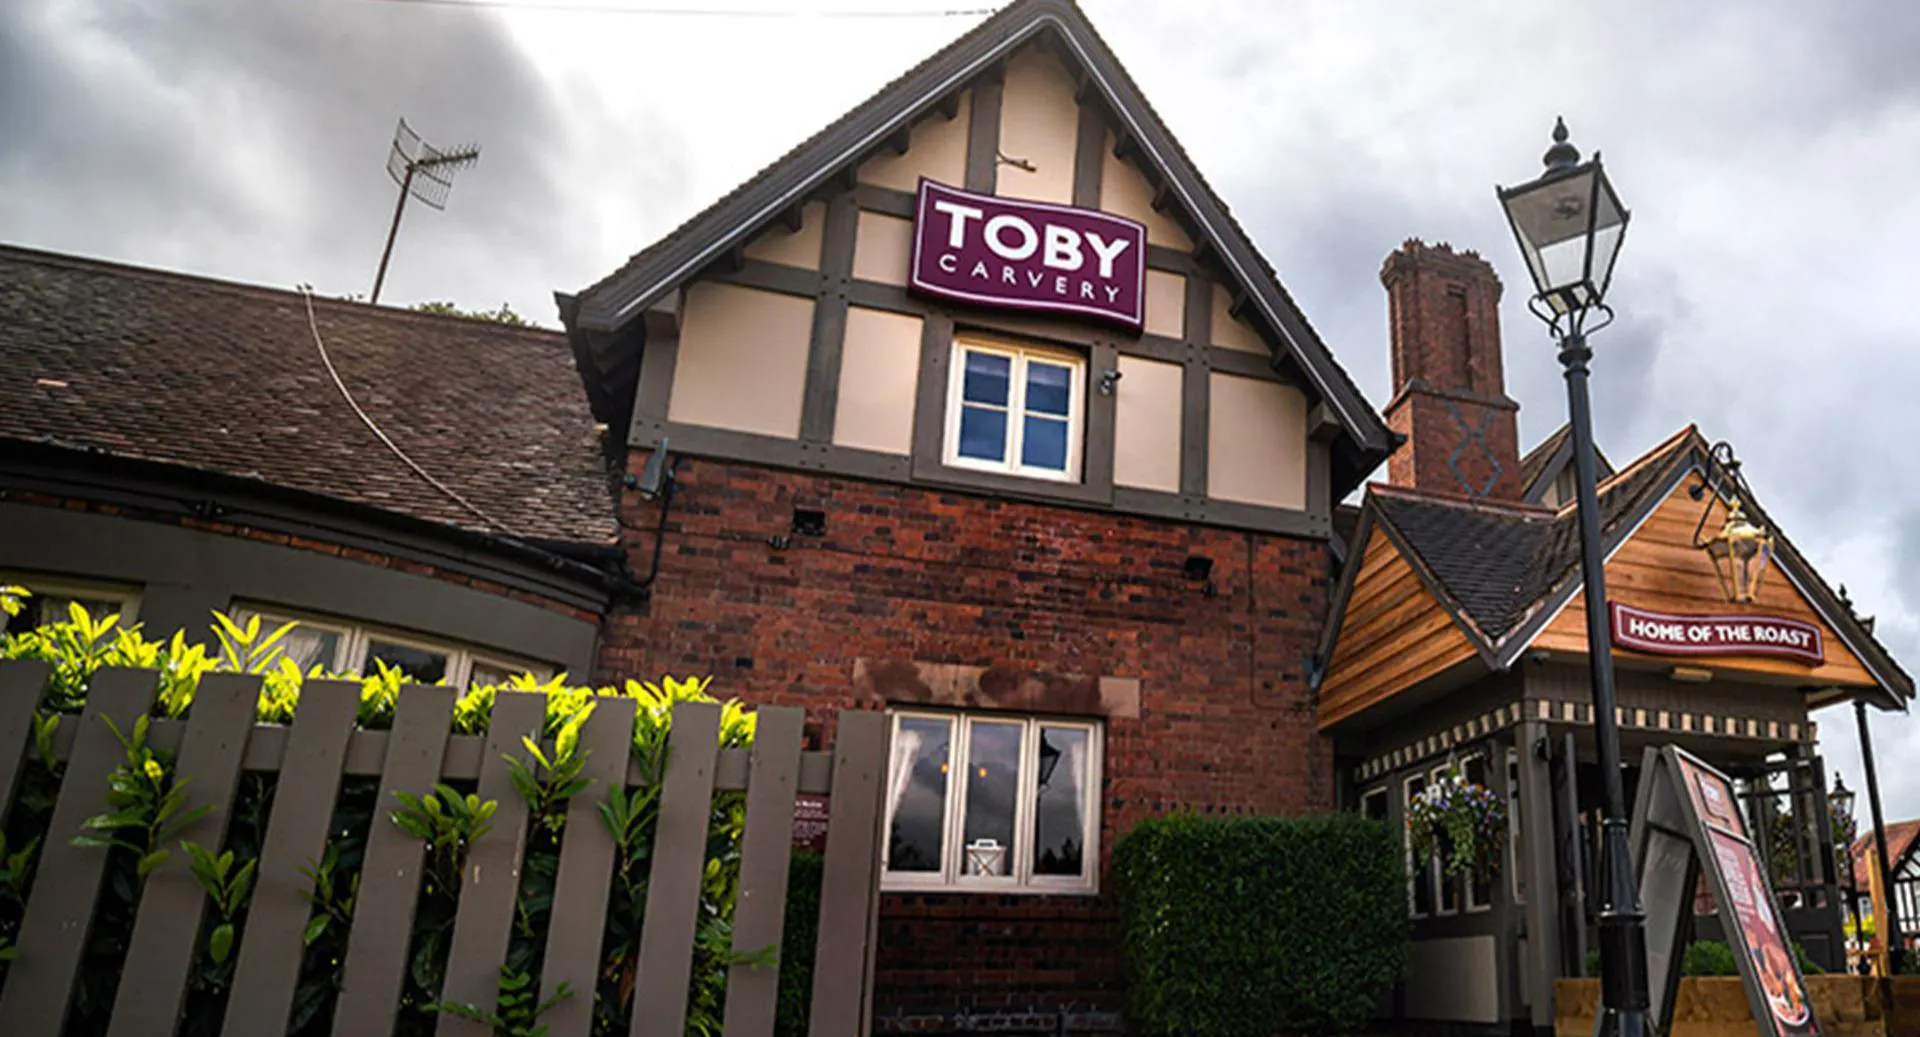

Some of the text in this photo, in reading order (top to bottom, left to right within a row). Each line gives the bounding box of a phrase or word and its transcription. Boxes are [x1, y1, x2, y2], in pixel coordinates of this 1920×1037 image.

[935, 200, 1130, 279] TOBY
[938, 254, 1119, 303] CARVERY
[1629, 618, 1811, 647] HOME OF THE ROAST
